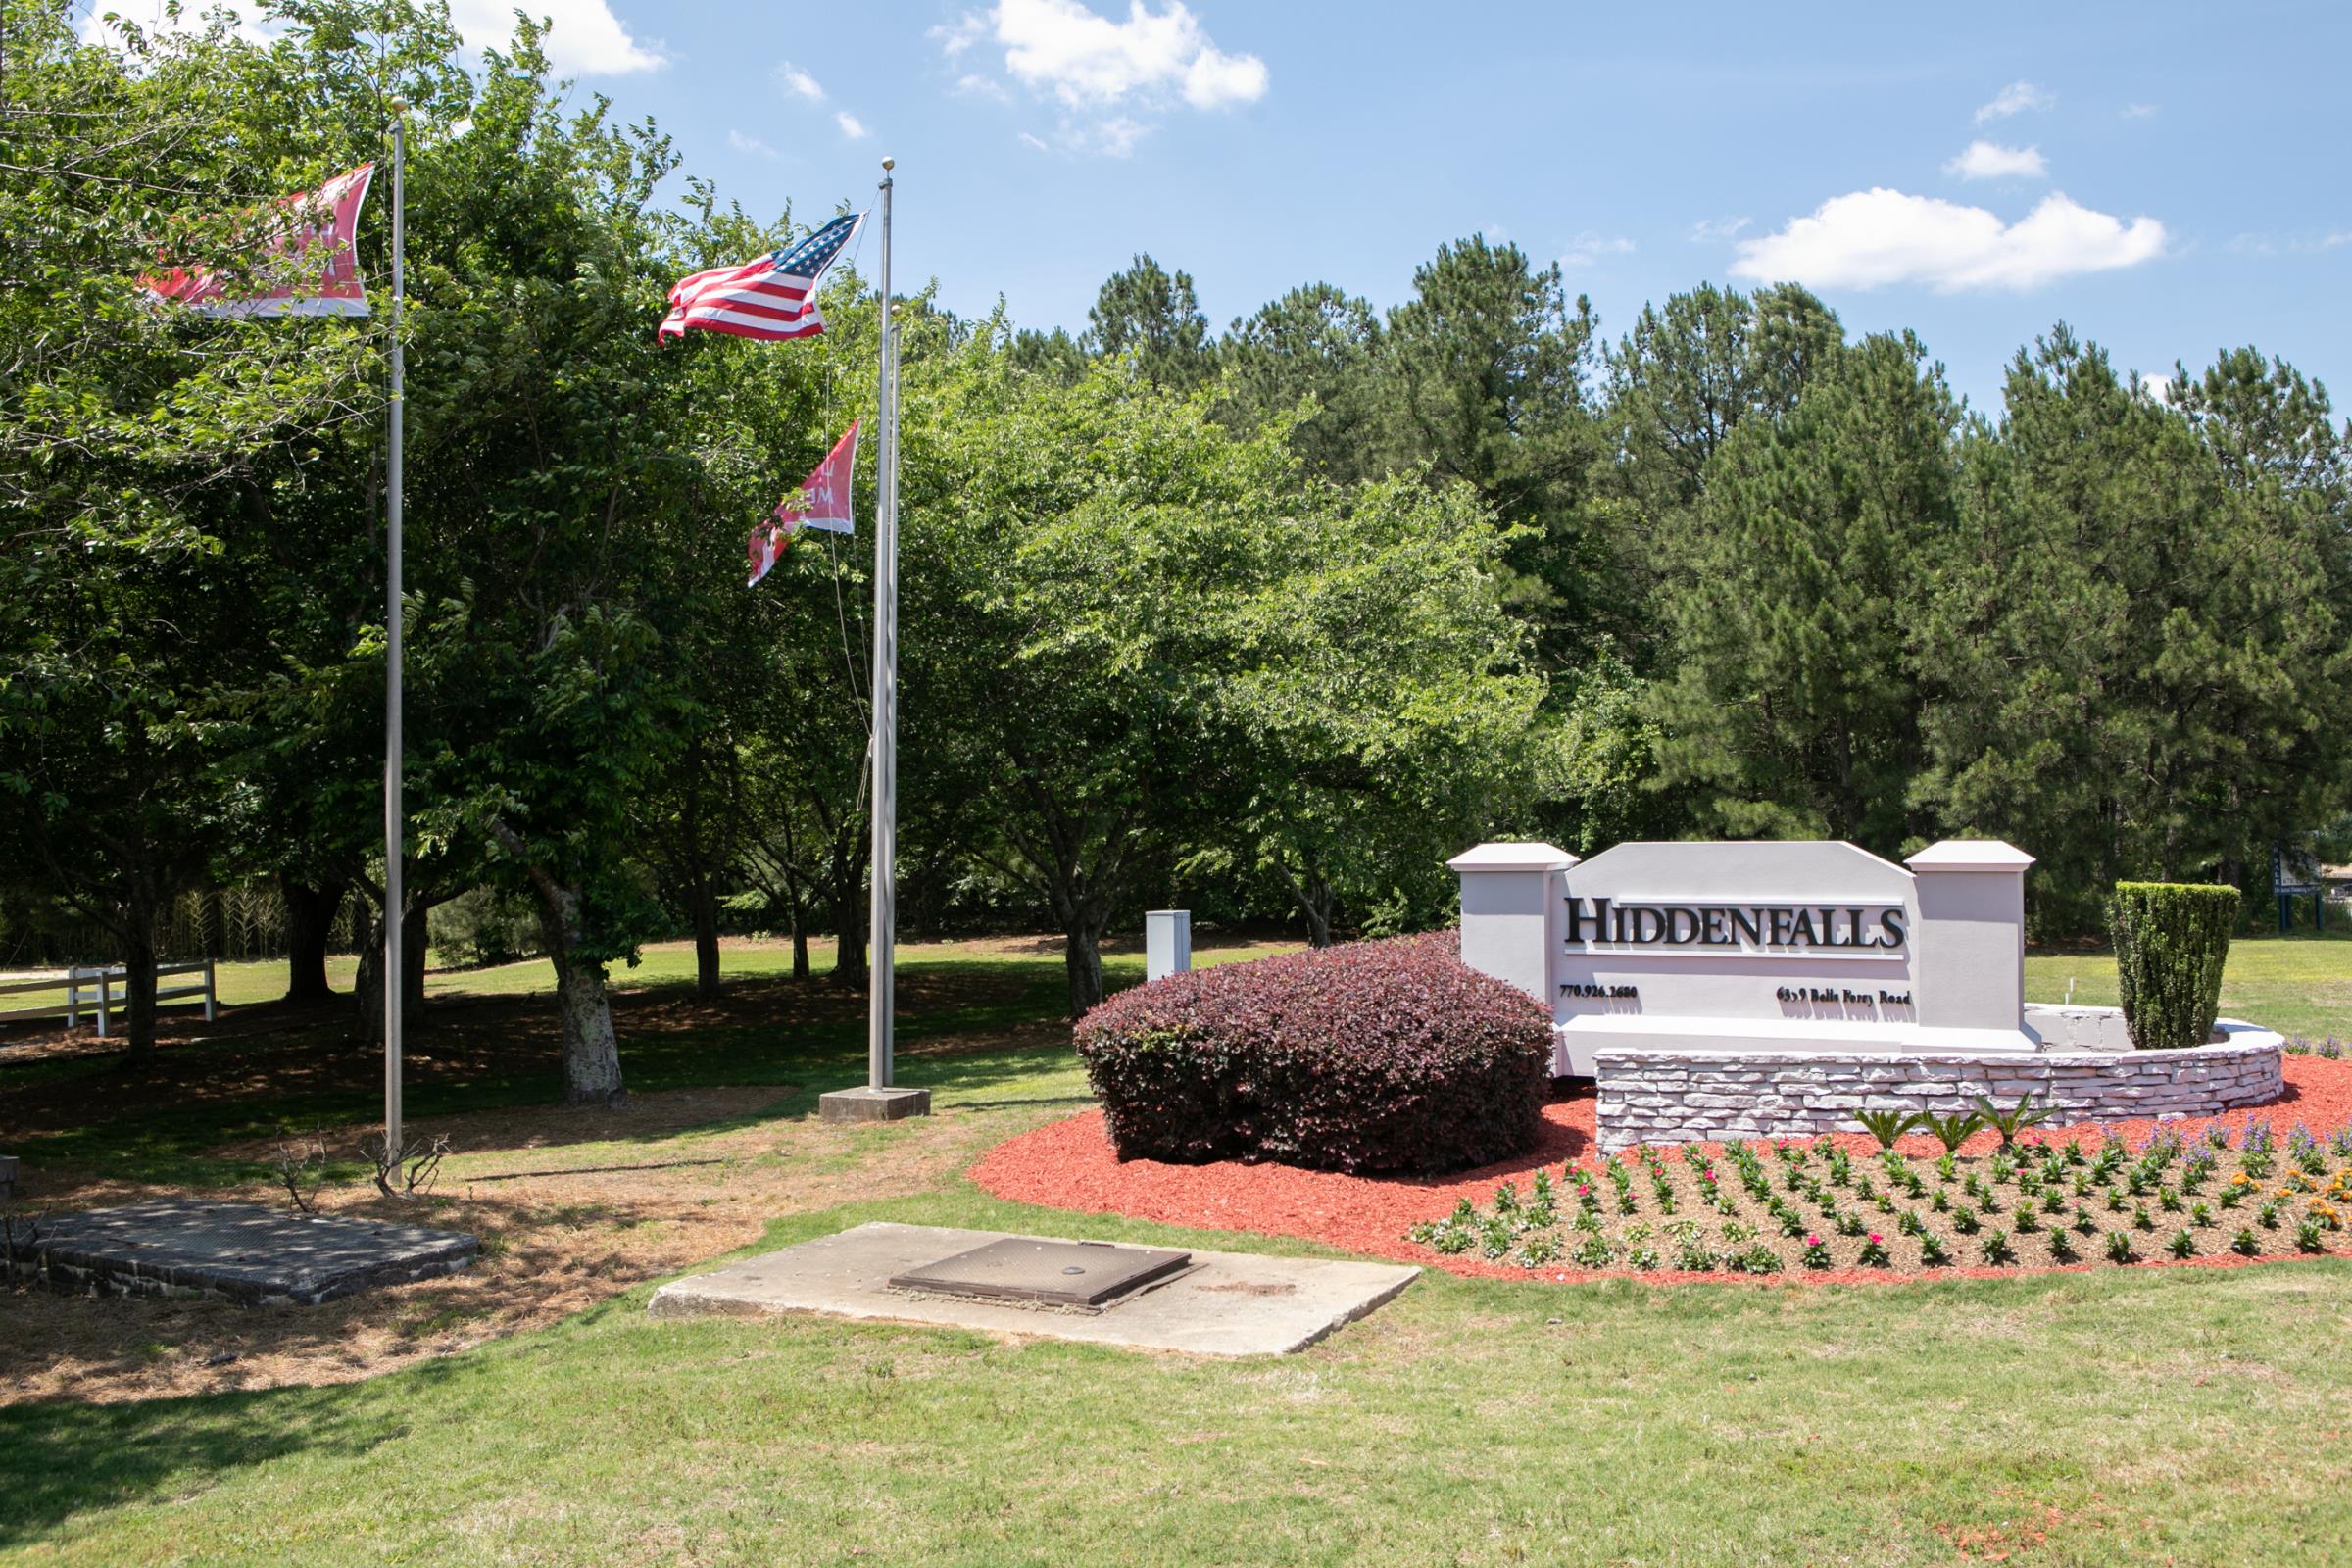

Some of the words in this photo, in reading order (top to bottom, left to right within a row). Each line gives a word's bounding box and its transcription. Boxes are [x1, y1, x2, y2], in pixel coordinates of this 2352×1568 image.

[1810, 988, 1839, 1002] Bells
[1842, 989, 1874, 1006] Ferry
[1879, 990, 1910, 1004] Road
